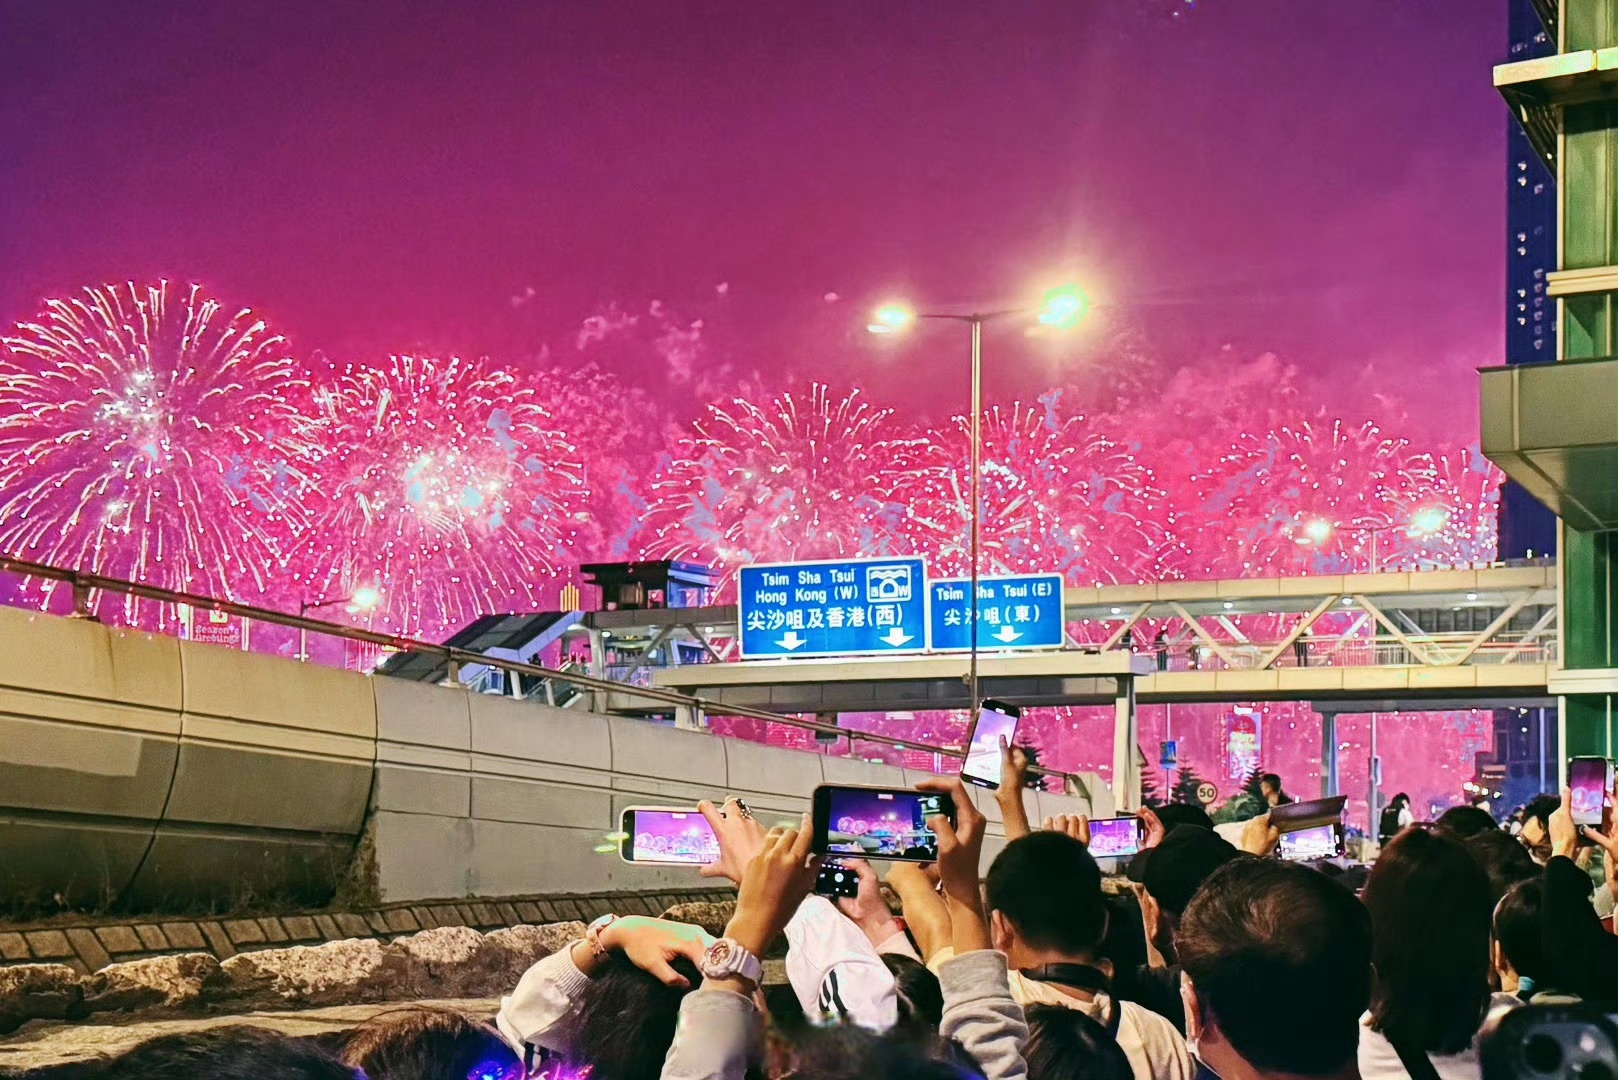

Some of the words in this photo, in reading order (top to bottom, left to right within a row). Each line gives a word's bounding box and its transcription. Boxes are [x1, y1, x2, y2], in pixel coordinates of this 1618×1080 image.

[761, 572, 790, 586] Tsim
[797, 570, 821, 585] Sha
[829, 568, 855, 583] Tsui
[755, 589, 787, 606] Hong
[795, 587, 827, 604] Kong
[834, 584, 858, 600] (W)
[936, 587, 964, 601] Tsim
[975, 585, 995, 600] ha
[1002, 584, 1028, 598] Tsui
[1032, 582, 1052, 597] (E)
[1200, 788, 1215, 798] 50
